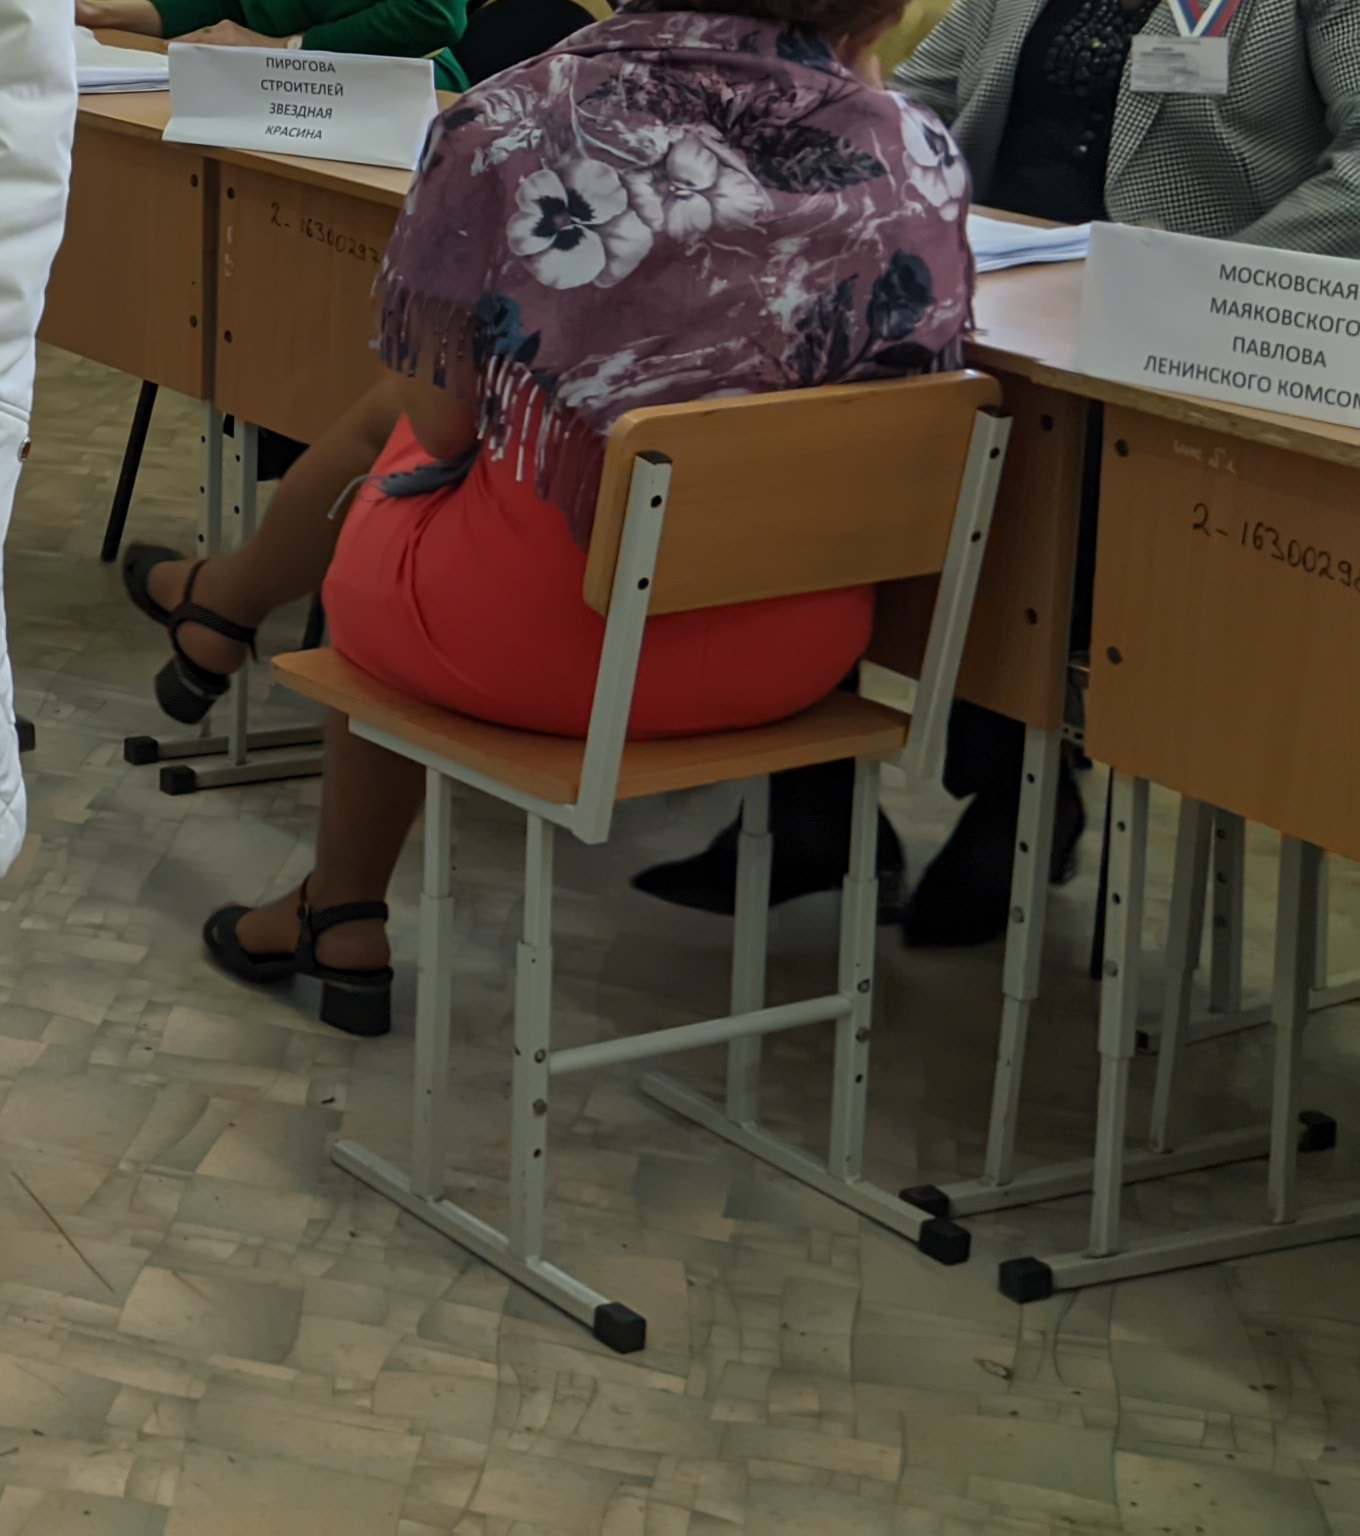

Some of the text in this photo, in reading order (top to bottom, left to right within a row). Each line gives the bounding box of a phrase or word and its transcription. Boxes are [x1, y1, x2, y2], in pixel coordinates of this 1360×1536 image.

[266, 57, 336, 73] ПИРОГОВА
[260, 79, 344, 97] СТРОИТЕЛЕЙ
[269, 102, 333, 119] ЗВЕЗДНАЯ
[265, 125, 322, 140] КРАСИНА
[1219, 263, 1359, 301] МОСКОВСКАЯ
[1209, 296, 1360, 337] МАЯКОВСКОГО
[1232, 336, 1327, 368] ПАВЛОВА
[1143, 355, 1272, 393] ЛЕНИНСКОГО
